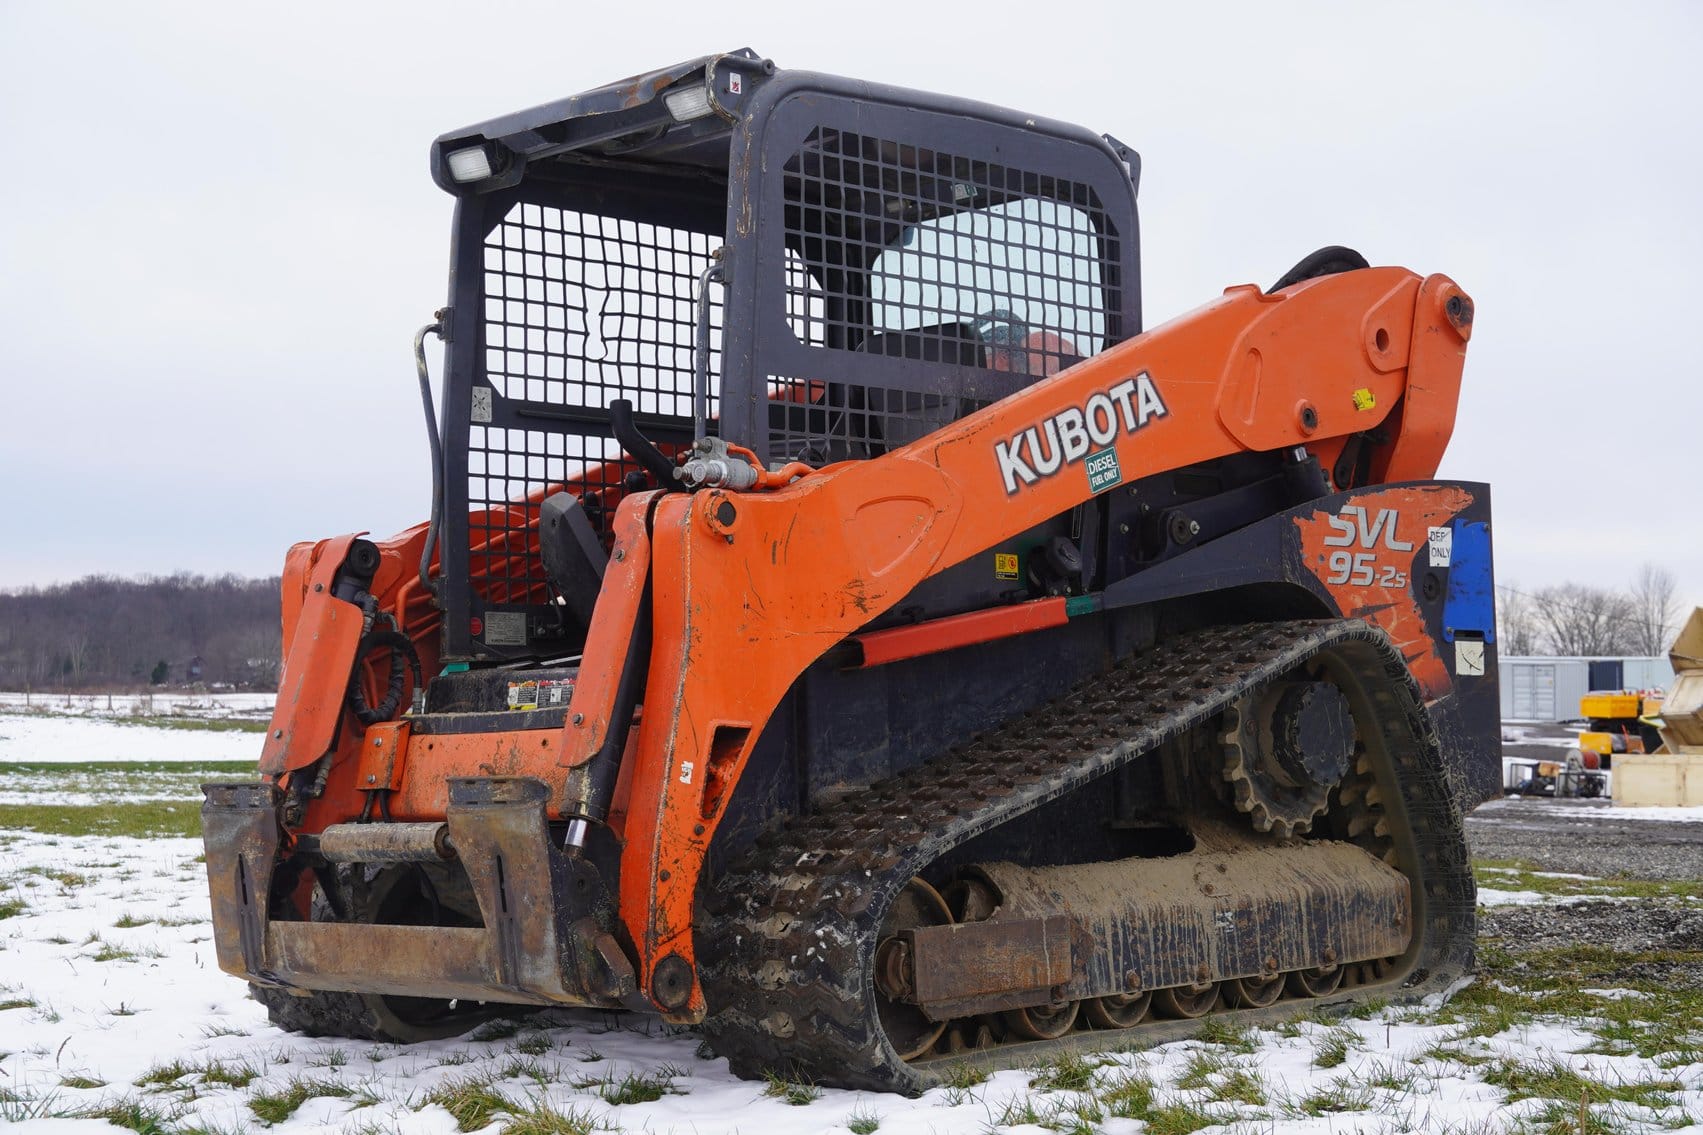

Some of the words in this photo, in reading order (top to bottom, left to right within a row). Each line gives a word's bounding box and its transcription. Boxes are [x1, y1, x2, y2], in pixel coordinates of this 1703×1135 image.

[996, 373, 1165, 494] KUBOTA
[1088, 454, 1116, 475] DIESEL
[1091, 474, 1105, 487] FUEL
[1103, 467, 1118, 481] ONLY
[1323, 505, 1414, 551] SVL
[1431, 546, 1450, 558] ONLY
